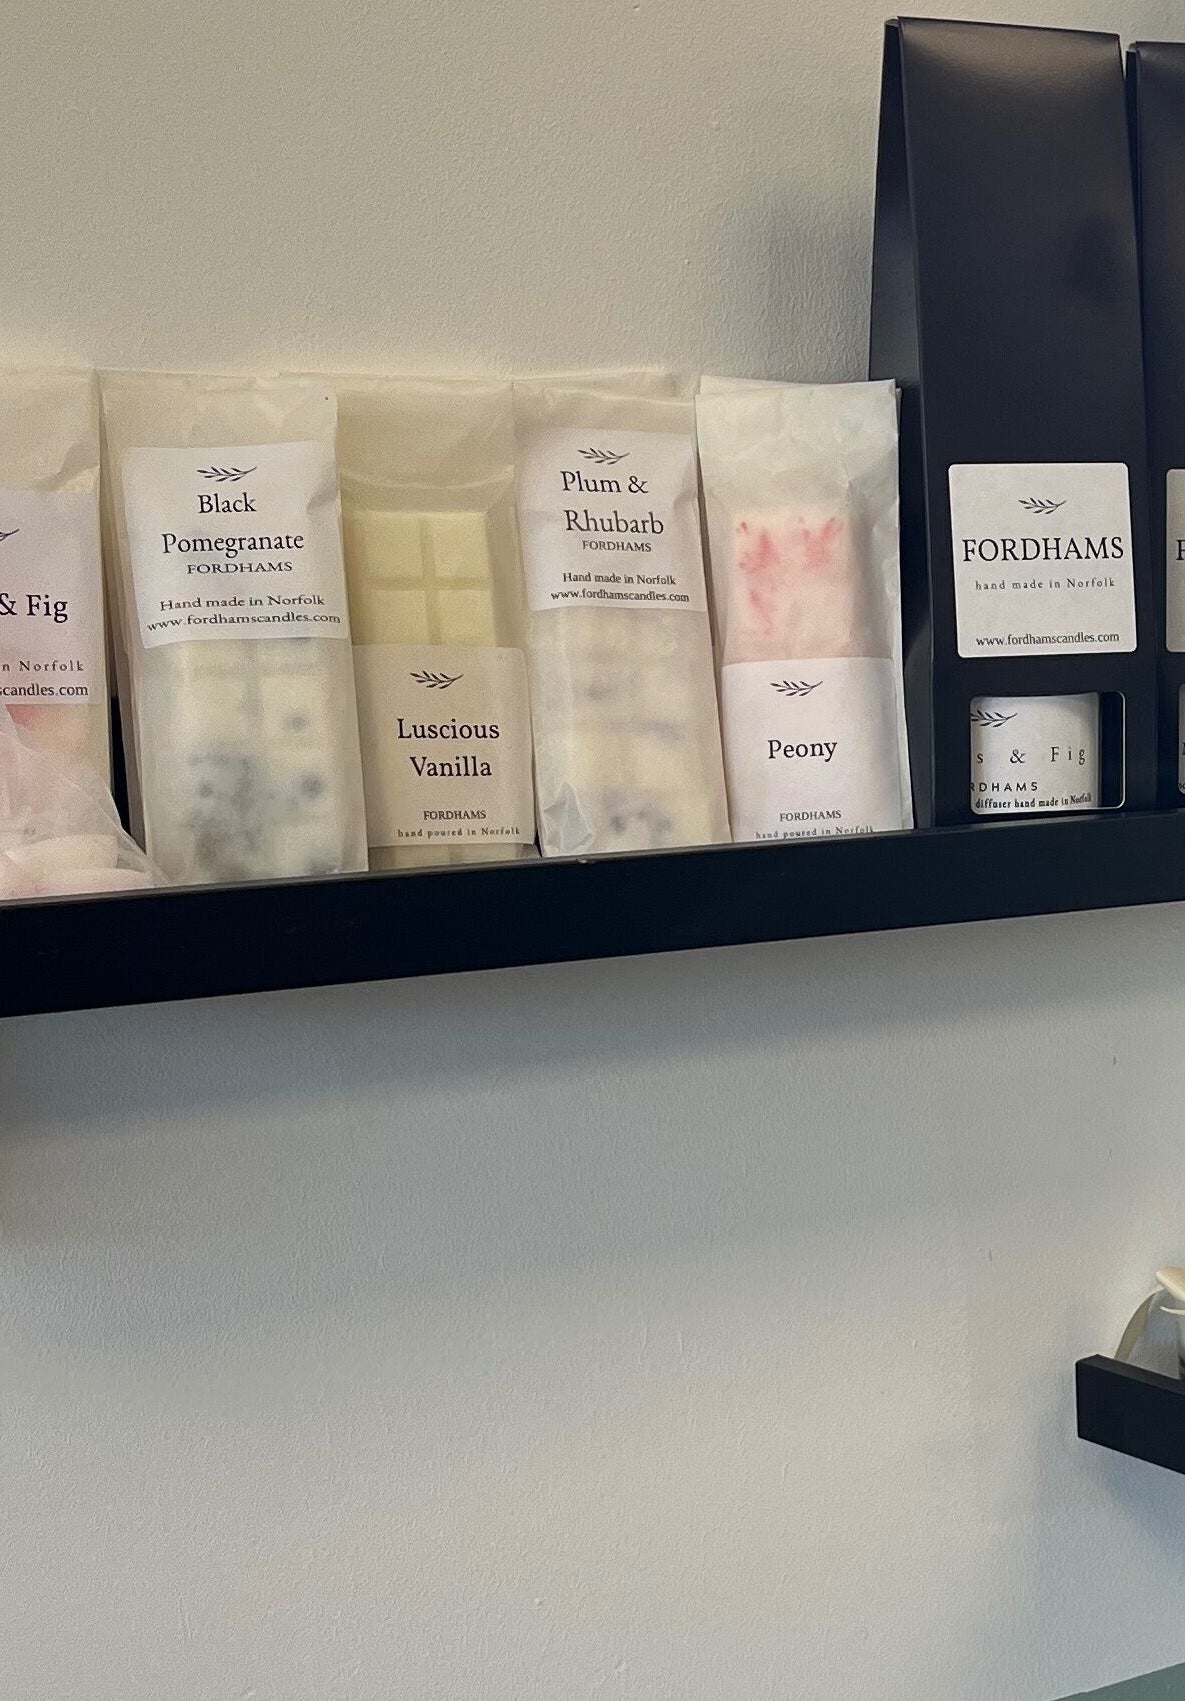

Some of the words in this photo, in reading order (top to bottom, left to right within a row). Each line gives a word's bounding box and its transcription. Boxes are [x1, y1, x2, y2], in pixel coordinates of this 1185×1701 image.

[560, 471, 621, 493] Plum
[628, 475, 649, 494] &
[197, 492, 257, 514] Black
[564, 509, 664, 535] Rhubarb
[162, 533, 304, 558] Pomegranate
[582, 540, 652, 553] FORDHAMS
[962, 536, 1124, 562] FORDHAMS
[187, 562, 293, 574] FORDHAMS
[563, 572, 592, 583] Hand
[594, 573, 621, 584] made
[624, 574, 634, 583] in
[636, 574, 677, 586] Norfolk
[975, 580, 1006, 591] hand
[1012, 579, 1043, 589] made
[1049, 579, 1061, 589] in
[1066, 577, 1116, 588] Norfolk
[160, 598, 201, 611] Hand
[206, 597, 245, 608] made
[250, 597, 263, 606] in
[267, 595, 325, 607] Norfolk
[551, 588, 690, 603] www.fordhamscandles.com
[0, 593, 17, 615] &
[26, 595, 68, 623] Fig
[147, 612, 341, 631] www.fordhamscandles.com
[976, 631, 1120, 646] www.fordhamscandles.com
[19, 660, 84, 671] Norfolk
[397, 718, 500, 739] Luscious
[768, 739, 838, 762] Peony
[1009, 749, 1026, 764] &
[1050, 746, 1086, 766] Fig
[410, 756, 492, 777] Vanilla
[975, 798, 1011, 809] diffuser
[1014, 798, 1035, 808] hand
[1038, 797, 1059, 807] made
[1061, 797, 1069, 805] in
[423, 810, 487, 821] FORDHAMS
[779, 810, 842, 822] FORDHAMS
[398, 829, 423, 838] hand
[428, 829, 463, 839] poured
[467, 829, 477, 837] in
[481, 827, 520, 836] Norfolk
[756, 830, 779, 839] hand
[783, 828, 817, 839] poured
[821, 827, 831, 836] in
[835, 825, 874, 835] Norfolk
